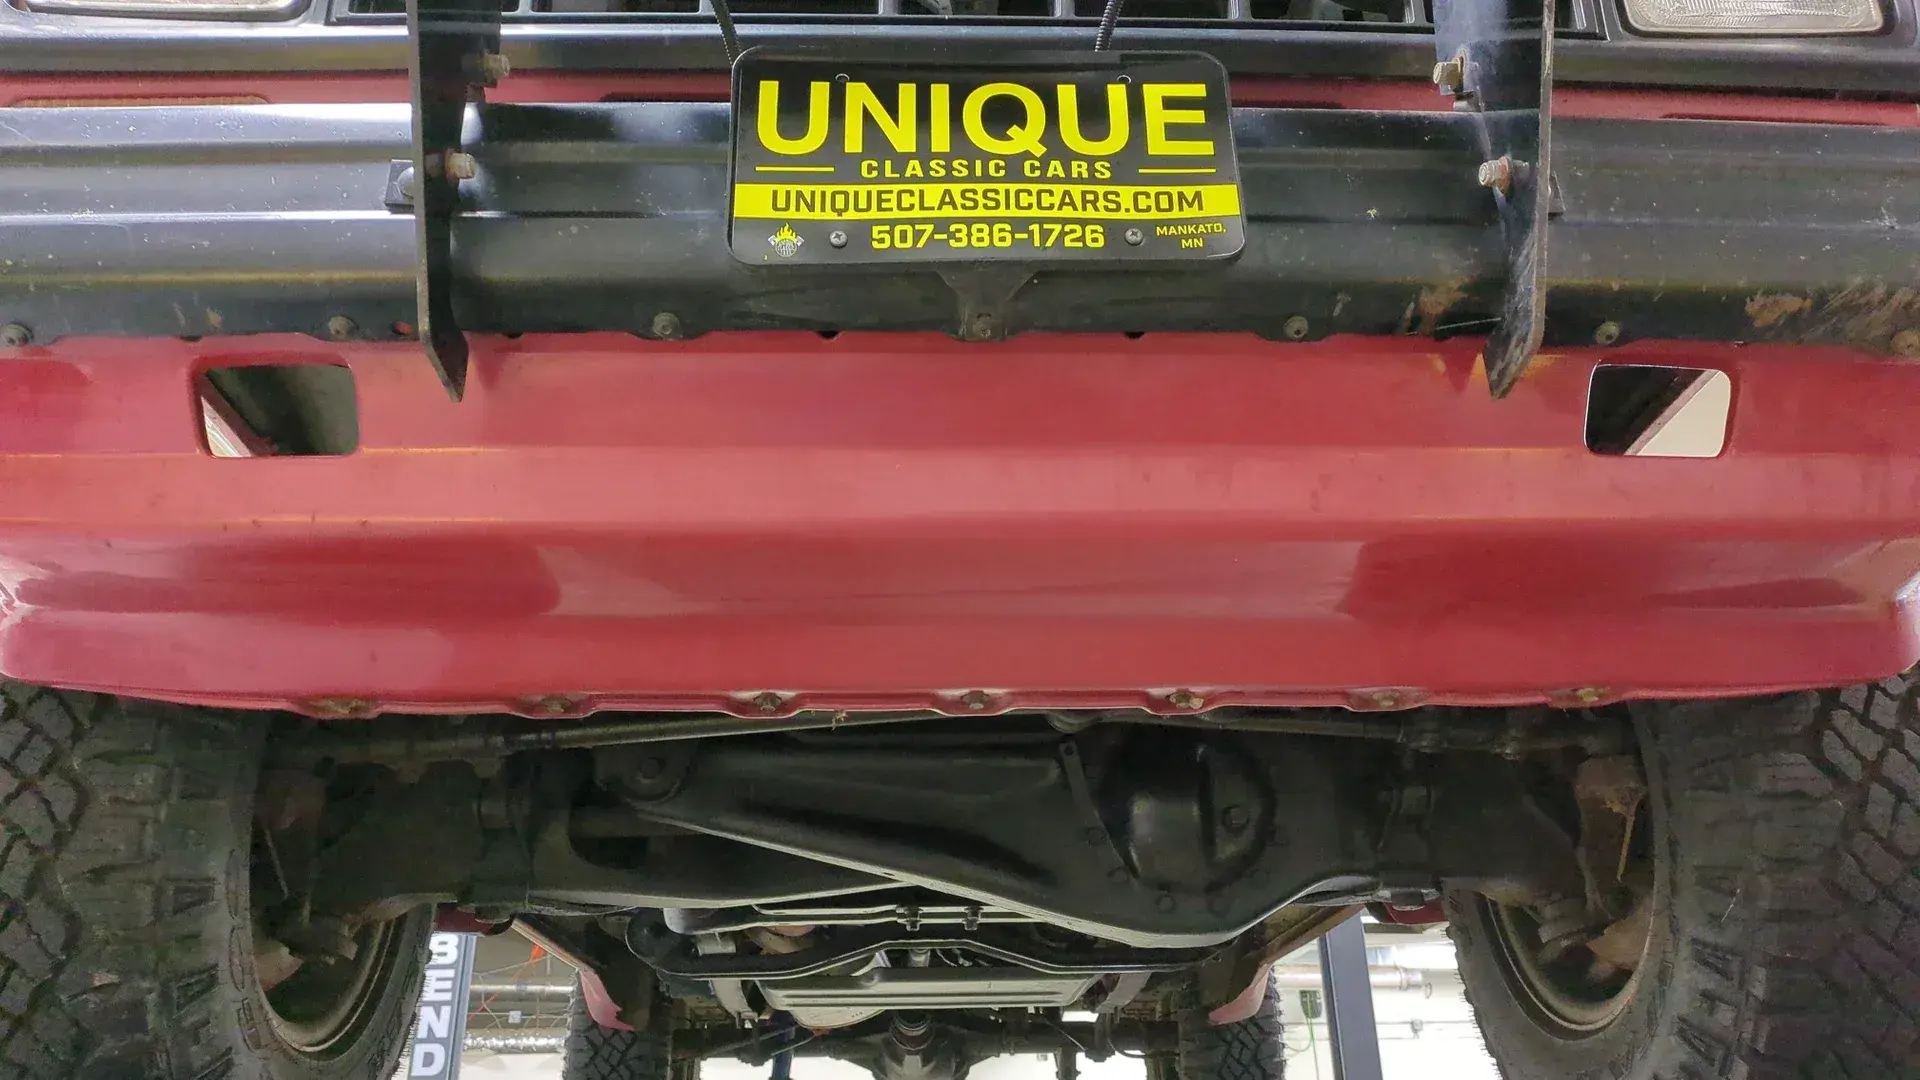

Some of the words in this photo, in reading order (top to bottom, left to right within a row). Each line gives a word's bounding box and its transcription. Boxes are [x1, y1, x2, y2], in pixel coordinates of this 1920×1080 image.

[756, 81, 1214, 158] UNIQUE
[860, 159, 1007, 178] CLASSIC
[1023, 160, 1113, 180] CARS
[771, 188, 1204, 217] UNIQUECLASSICCARS.COM
[870, 223, 1105, 250] 507-386-1726
[1155, 222, 1227, 237] MANKATO,
[1180, 237, 1204, 250] MN
